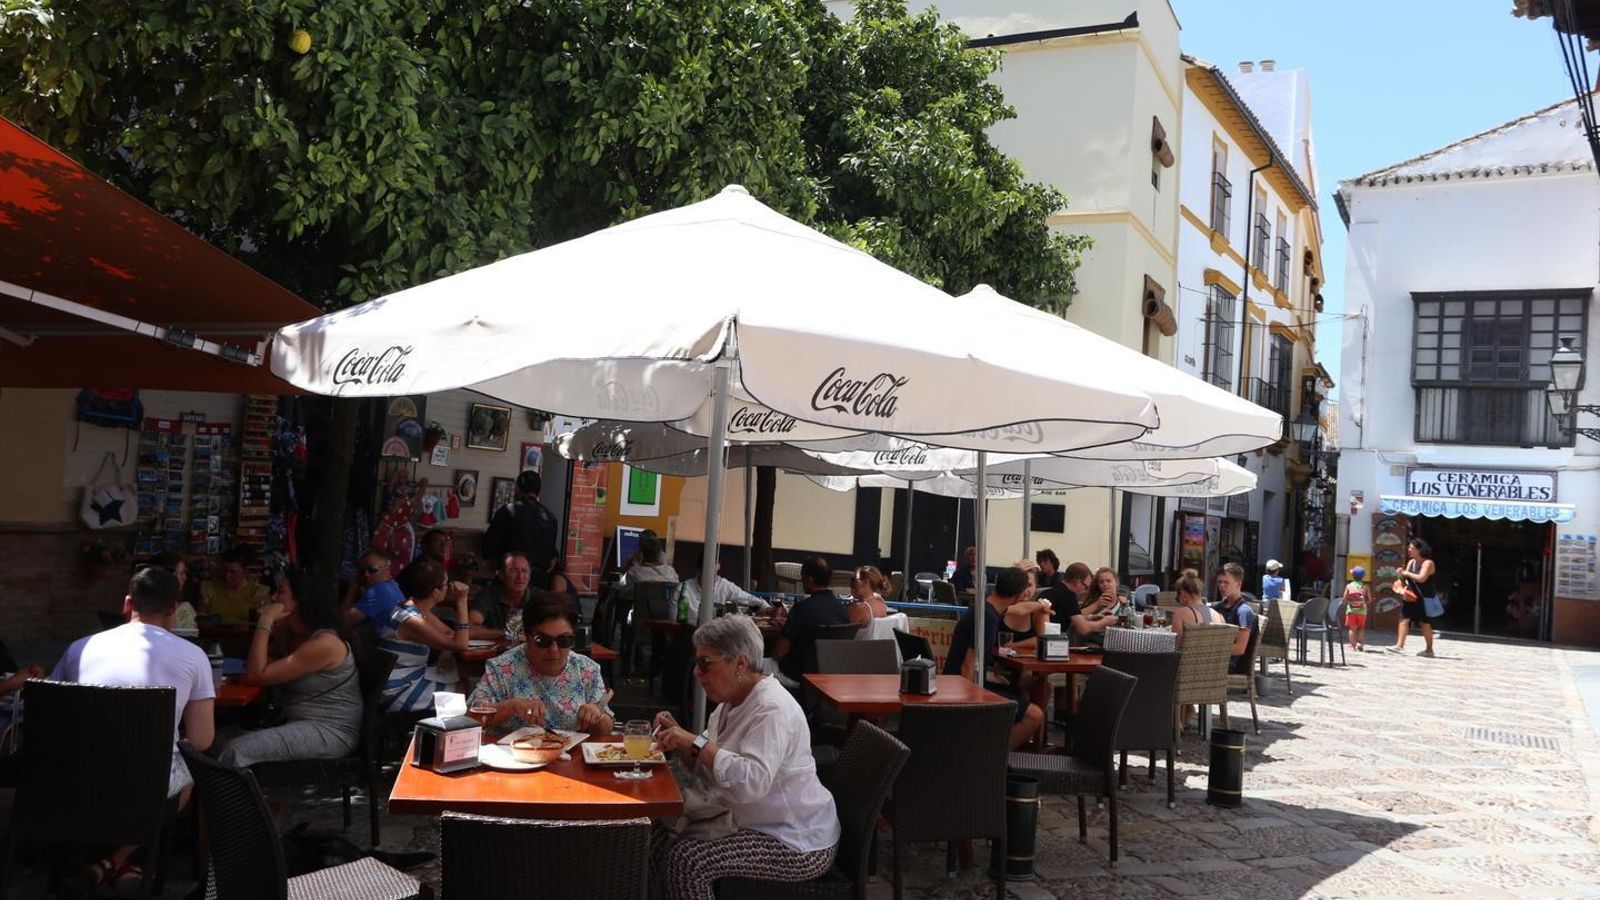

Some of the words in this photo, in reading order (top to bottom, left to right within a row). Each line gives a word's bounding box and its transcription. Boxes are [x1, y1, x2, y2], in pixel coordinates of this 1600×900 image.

[1412, 482, 1441, 496] LOS
[1446, 483, 1551, 501] VENERABLES
[1455, 503, 1478, 515] LOS
[1483, 505, 1560, 519] VENERABLES
